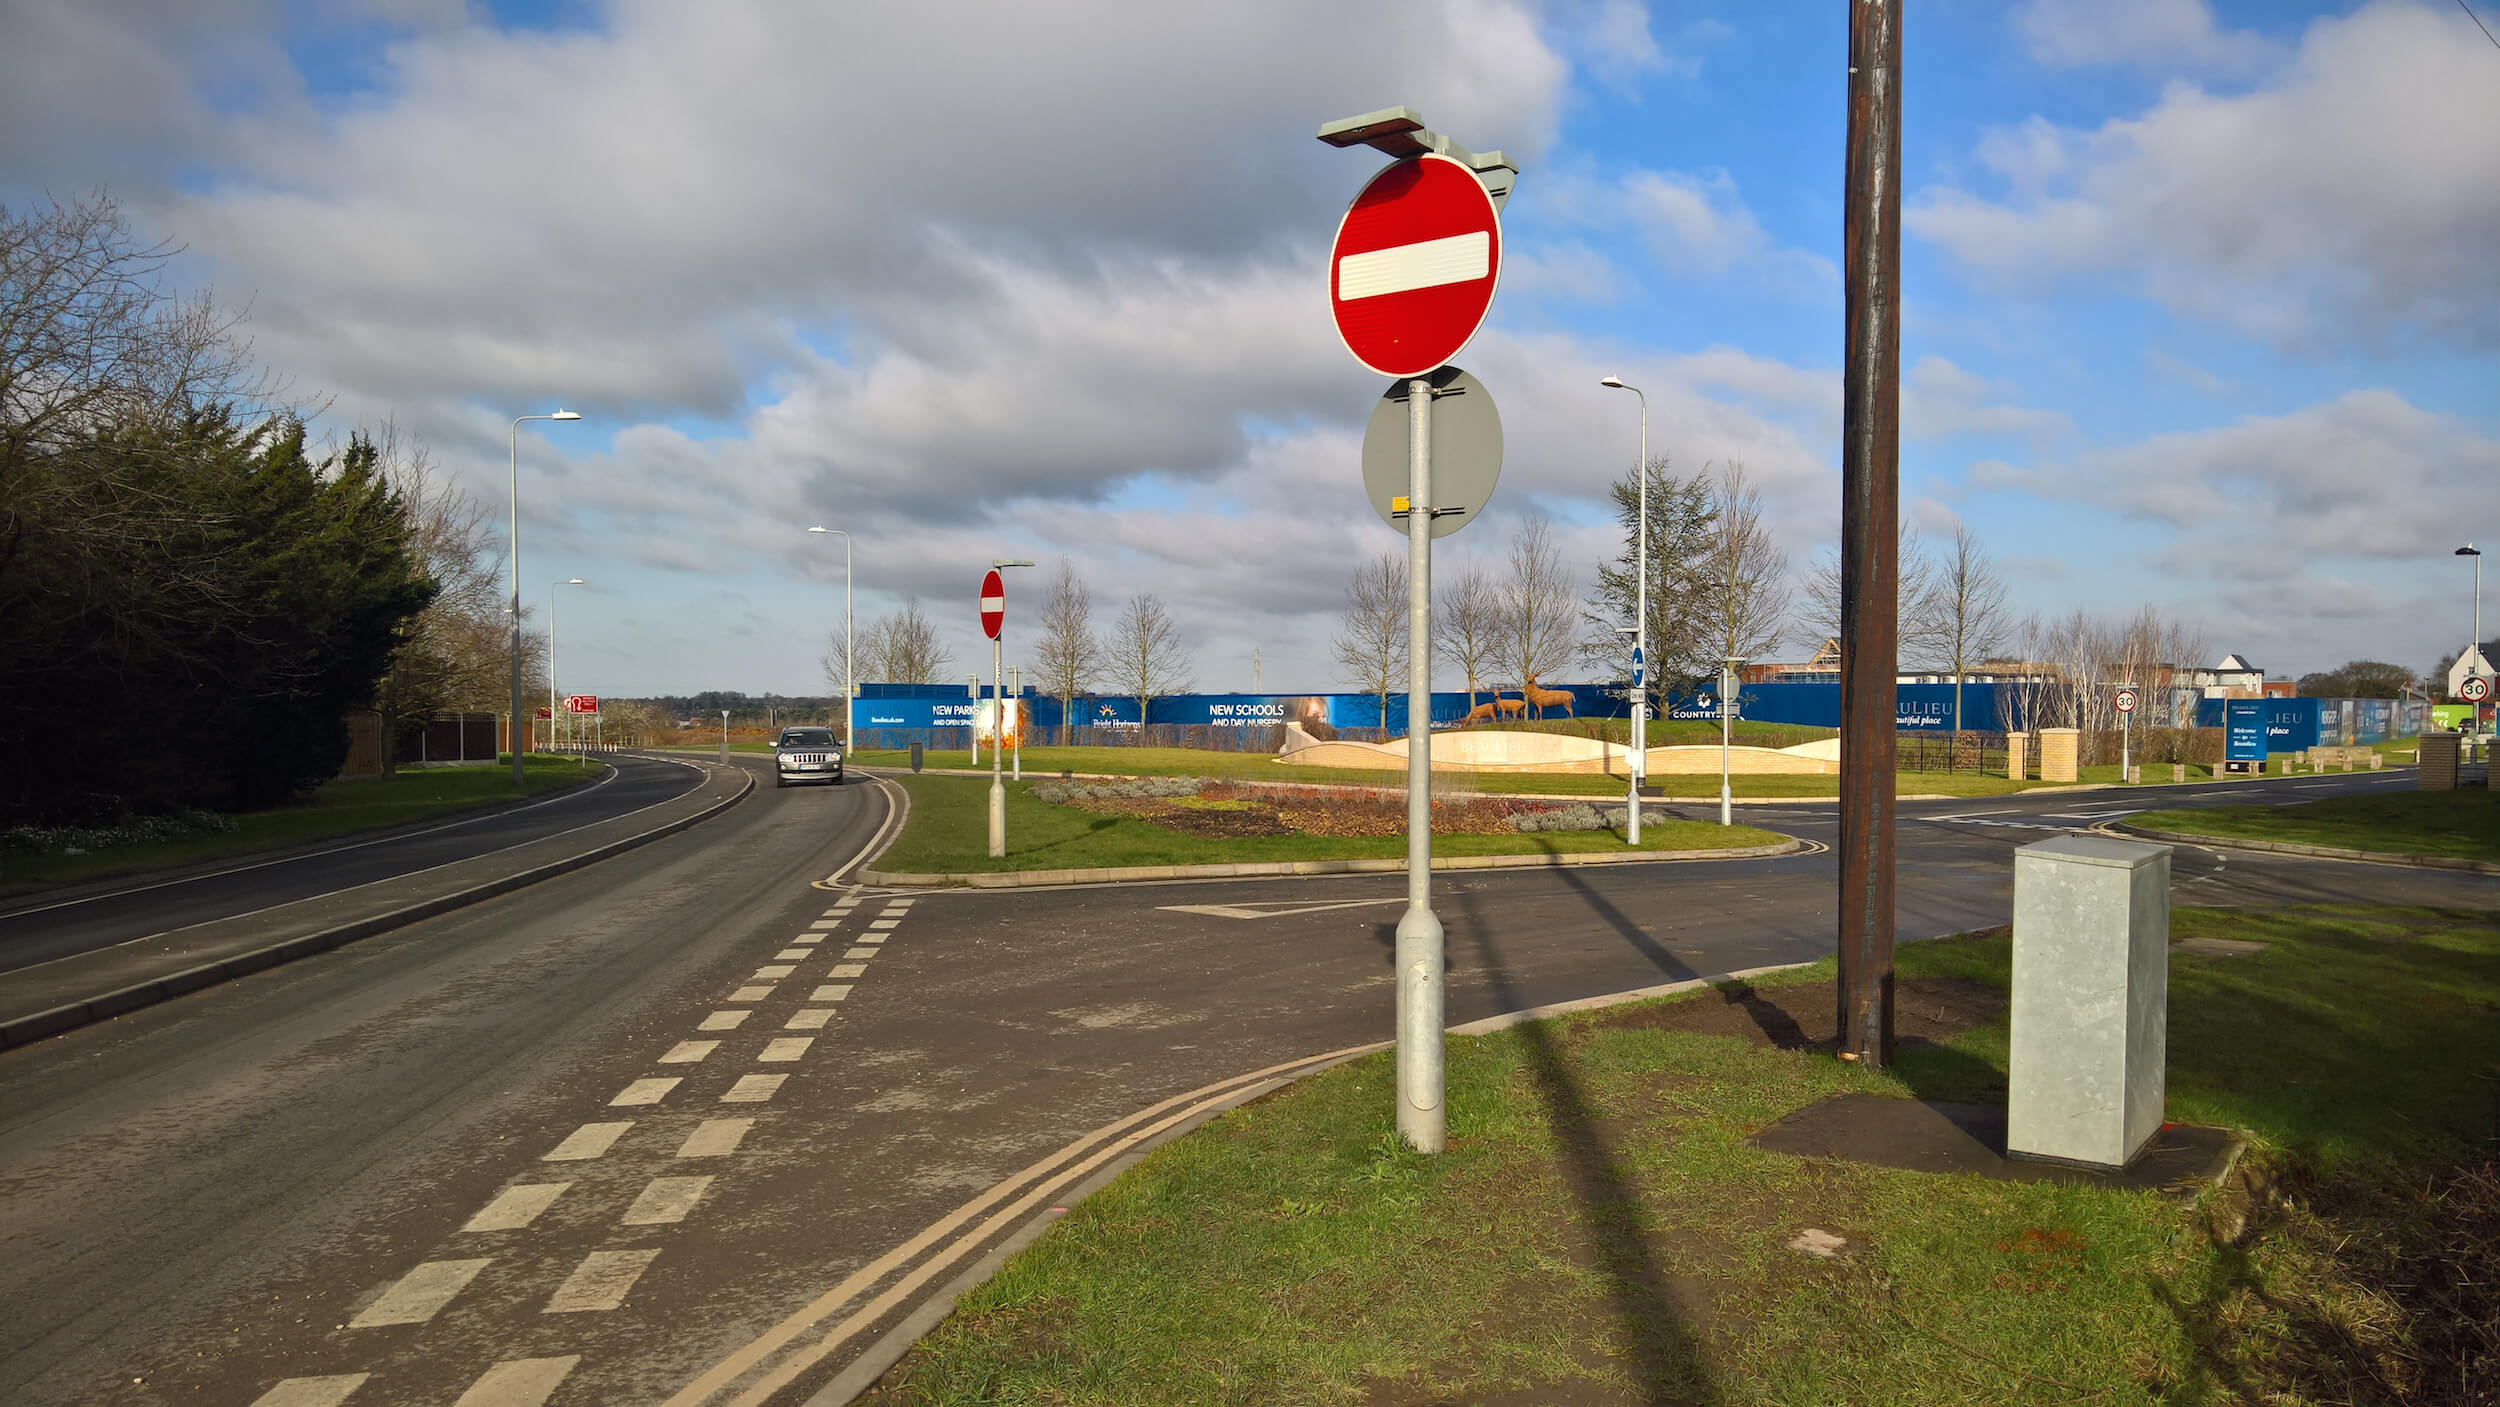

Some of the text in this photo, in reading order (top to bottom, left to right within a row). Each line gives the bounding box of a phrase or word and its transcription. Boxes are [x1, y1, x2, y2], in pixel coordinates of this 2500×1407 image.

[2465, 685, 2485, 695] 30
[2118, 697, 2133, 706] 30
[932, 705, 952, 715] NEW
[1209, 704, 1284, 715] NEW SCHOOLS
[1896, 701, 1953, 715] ULIEU
[1212, 718, 1282, 727] AND DAY NURSERY
[1896, 715, 1941, 726] autiful place
[2269, 728, 2289, 736] place
